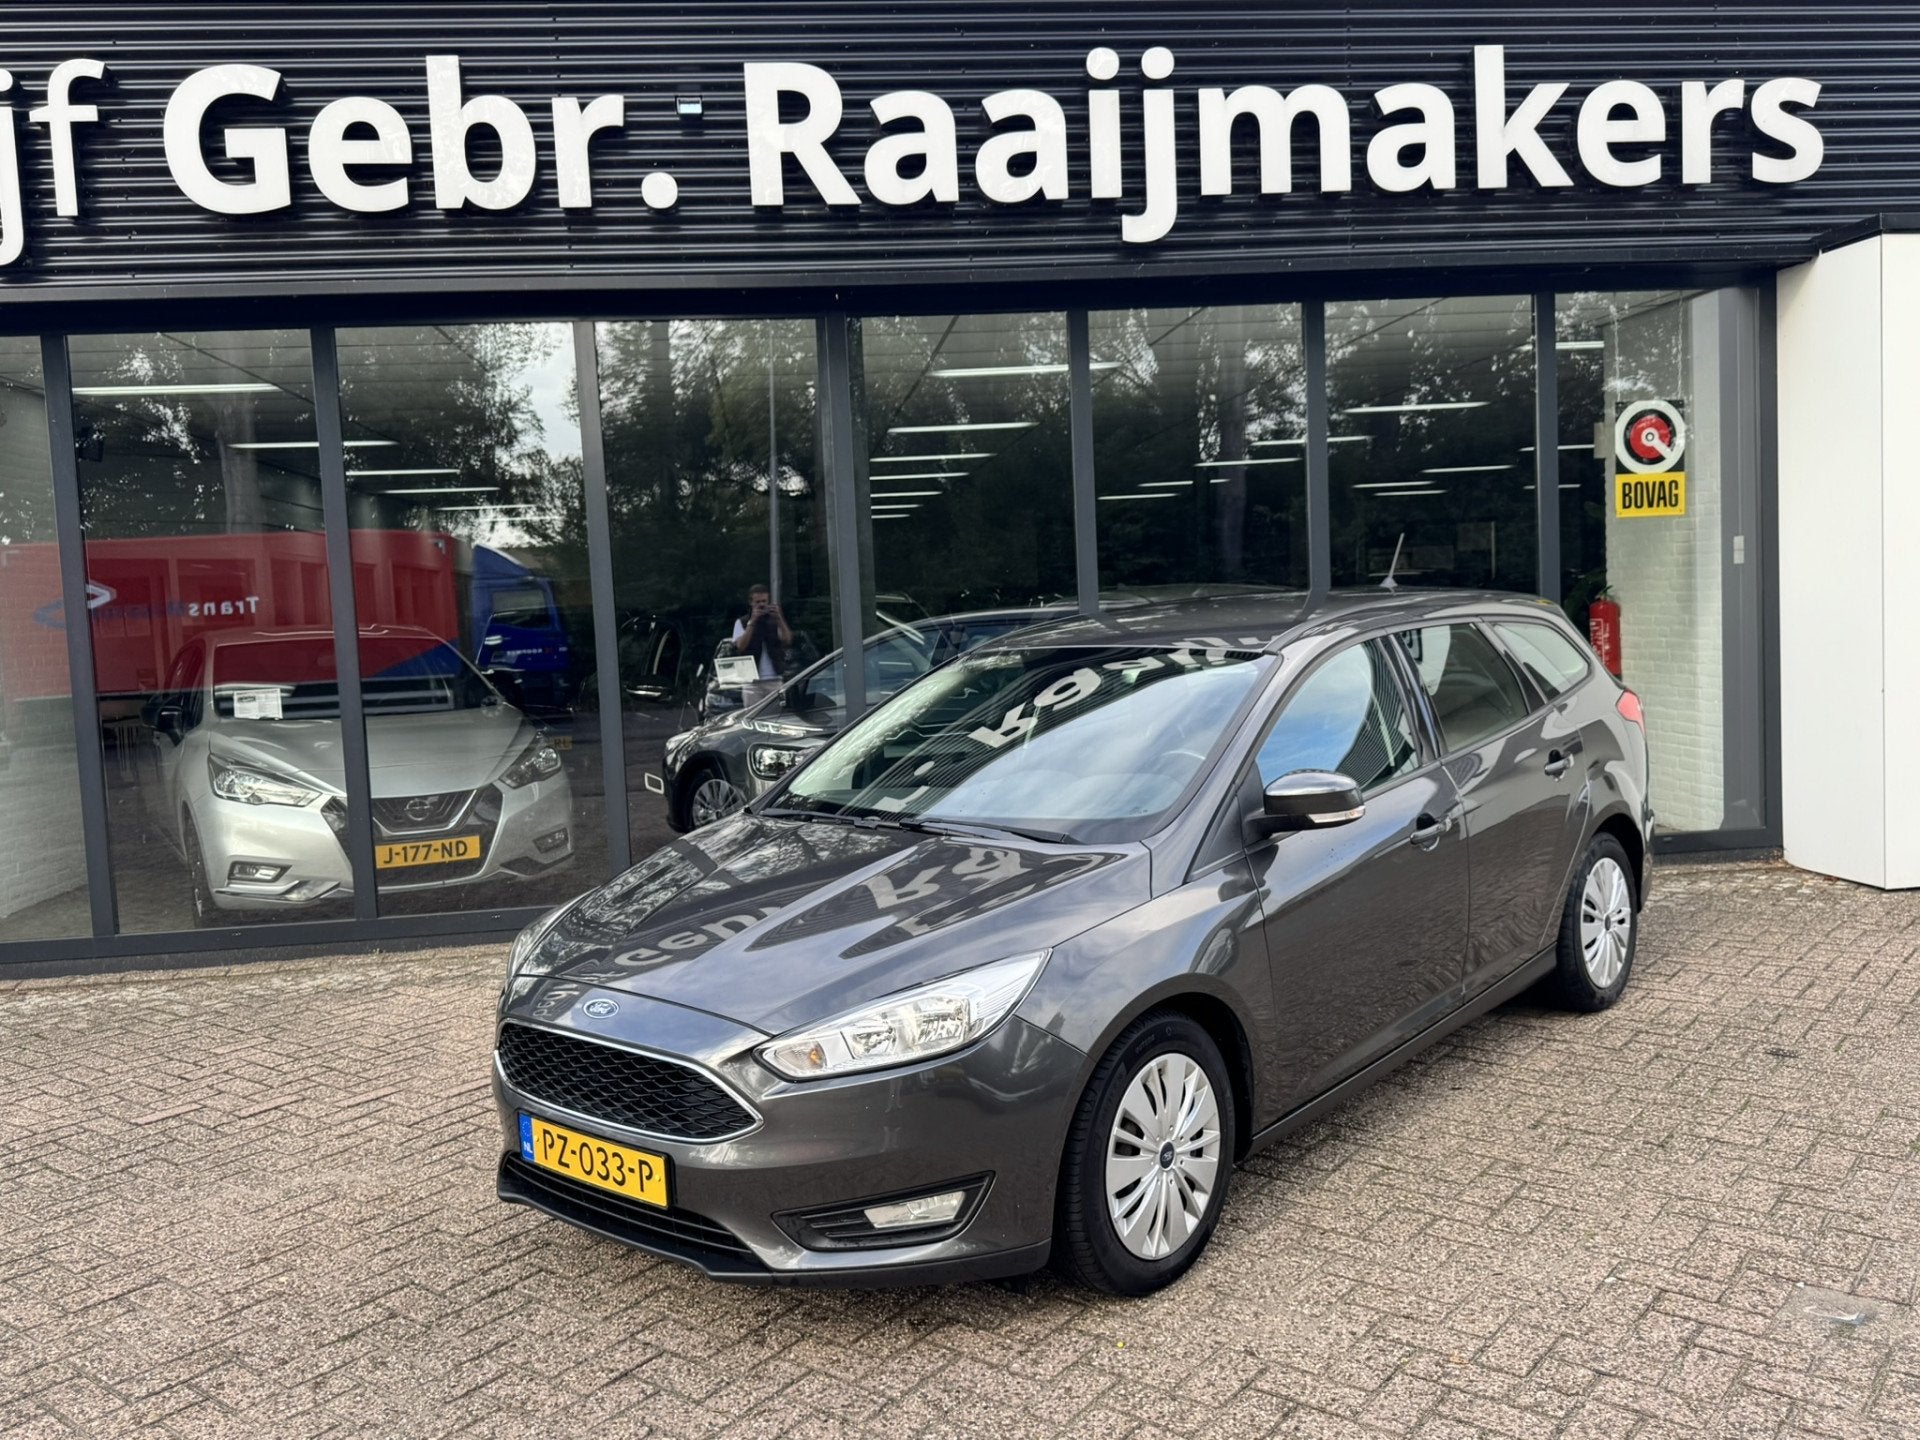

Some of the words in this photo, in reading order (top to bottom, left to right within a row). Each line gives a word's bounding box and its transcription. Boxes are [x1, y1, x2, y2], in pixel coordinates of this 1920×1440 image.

[162, 55, 679, 214] Gebr.
[743, 45, 1825, 244] Raaijmakers
[1621, 479, 1680, 510] BOVAG
[383, 840, 469, 864] J-177-ND
[542, 1128, 654, 1193] PZ-033-P
